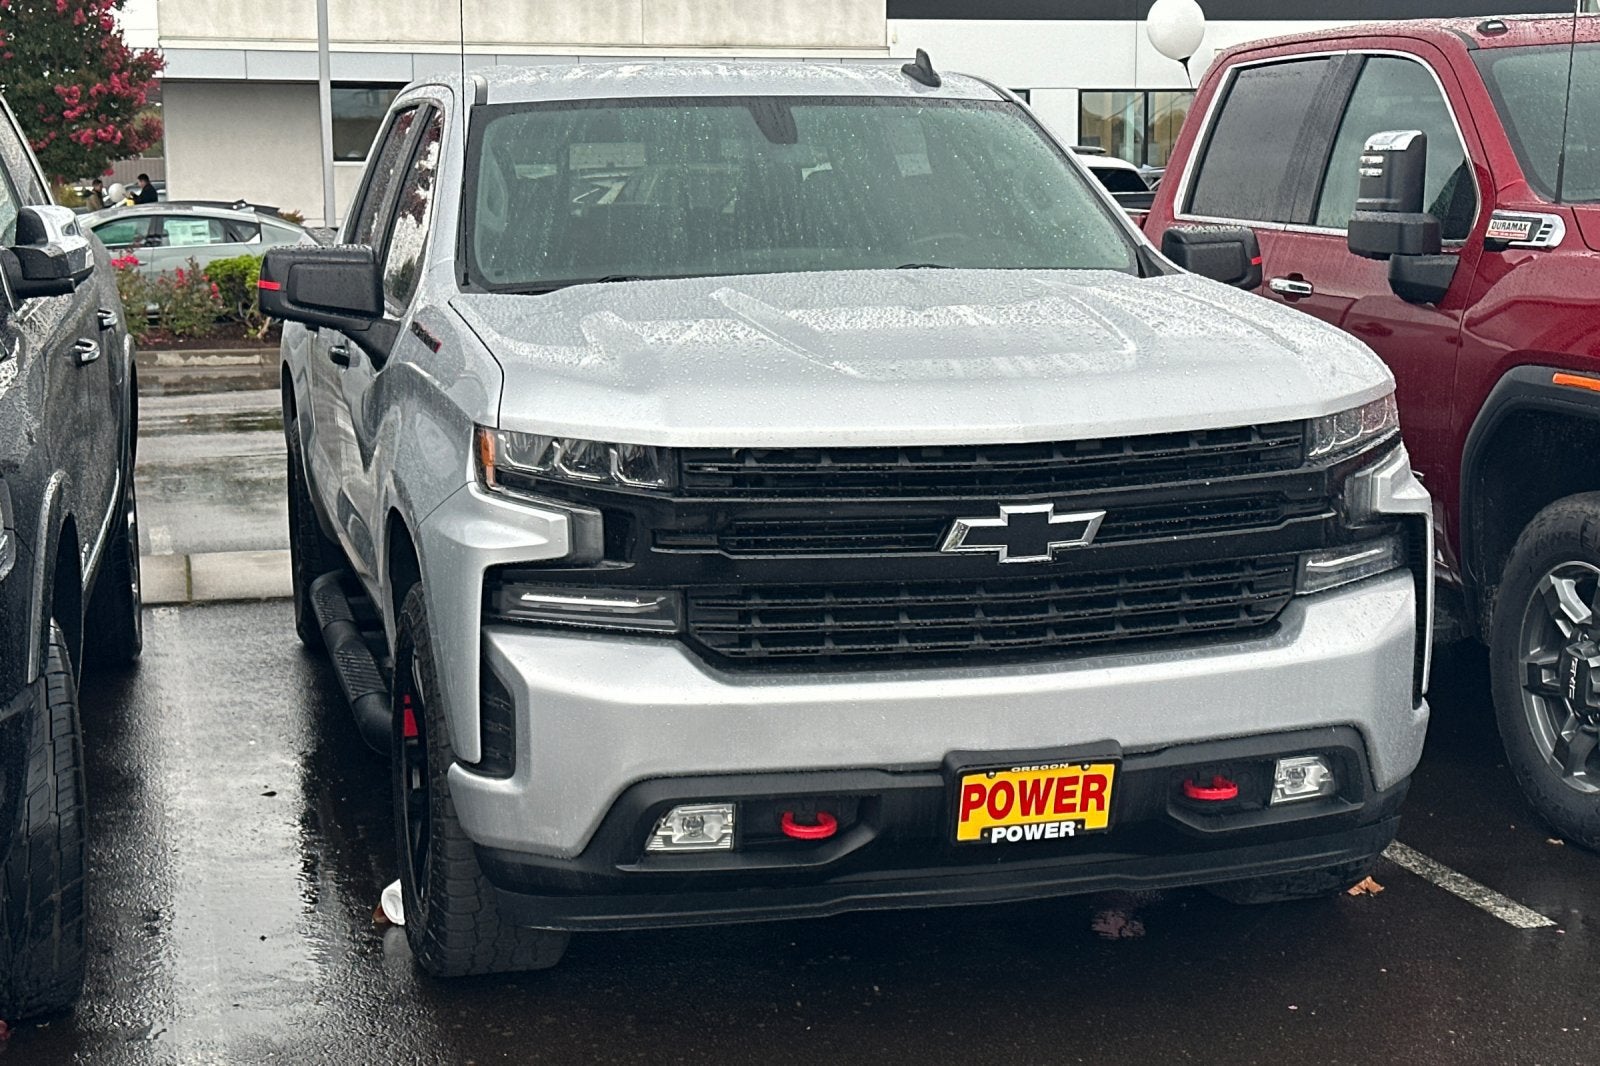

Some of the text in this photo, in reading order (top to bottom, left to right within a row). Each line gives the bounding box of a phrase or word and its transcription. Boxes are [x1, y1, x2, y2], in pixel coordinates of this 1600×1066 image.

[1491, 221, 1528, 231] DURAMAX
[1011, 763, 1069, 773] OREGON
[960, 774, 1108, 822] POWER
[991, 821, 1076, 844] POWER
